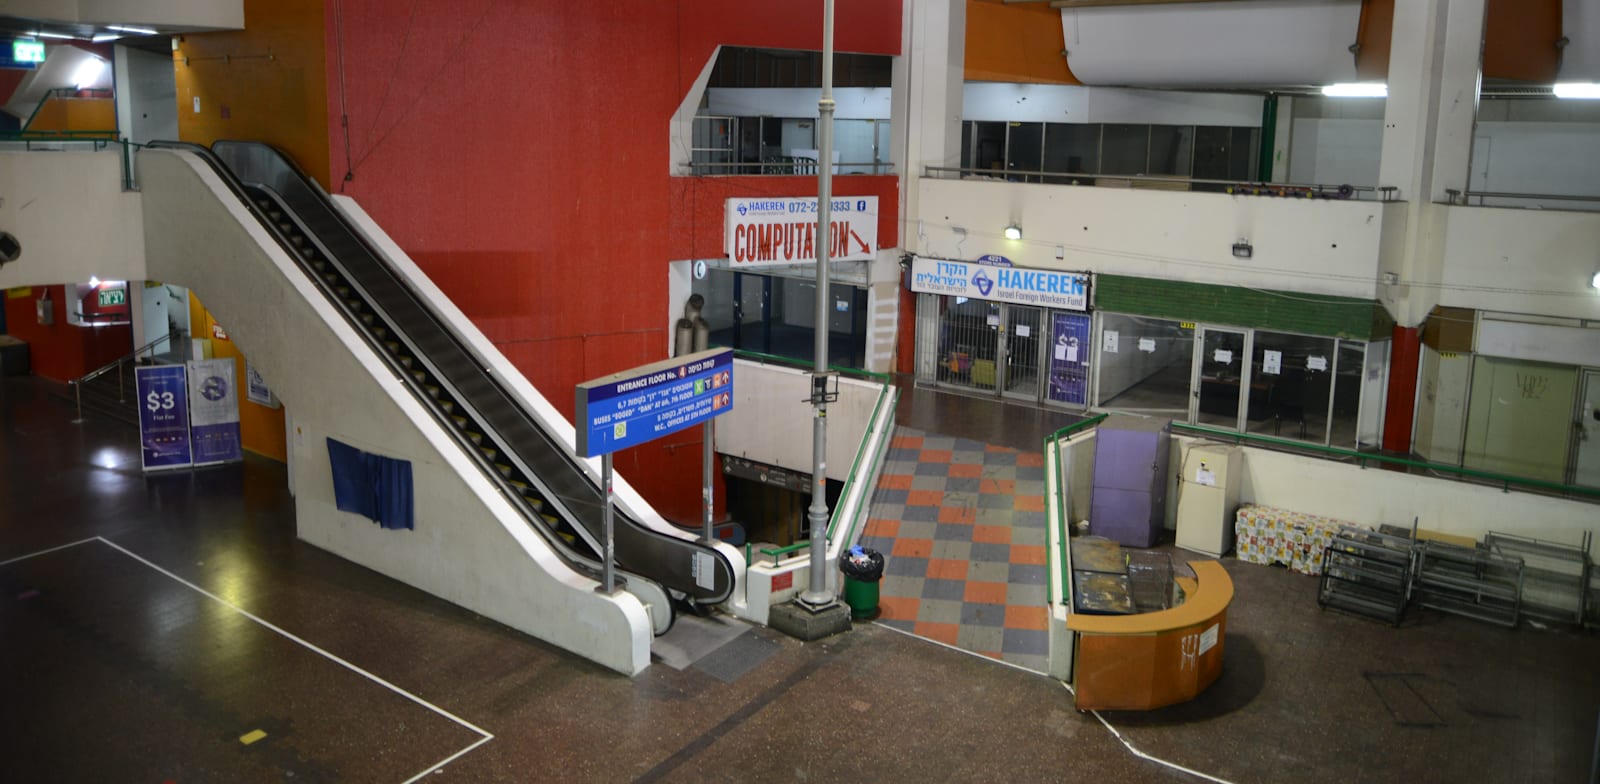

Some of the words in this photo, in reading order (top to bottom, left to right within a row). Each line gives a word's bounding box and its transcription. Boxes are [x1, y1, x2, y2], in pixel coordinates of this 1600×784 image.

[749, 201, 785, 211] HAKEREN
[788, 200, 850, 213] 072-2333
[735, 220, 850, 262] COMPUTATON
[936, 261, 968, 276] הקרן
[916, 272, 967, 287] הישראלית
[997, 268, 1085, 297] HAKEREN
[997, 289, 1015, 298] Israel
[1015, 291, 1038, 303] Foreign
[1039, 294, 1066, 305] Workers
[1067, 297, 1083, 306] Fund
[617, 377, 648, 393] ENTRANCE
[648, 373, 666, 385] FLOOR
[667, 371, 677, 380] No.
[146, 390, 175, 413] $3
[593, 414, 611, 426] BUSES
[654, 400, 661, 409] AT
[679, 390, 694, 401] FLOOR
[667, 415, 684, 427] OFFICES
[699, 406, 712, 417] FLOOR
